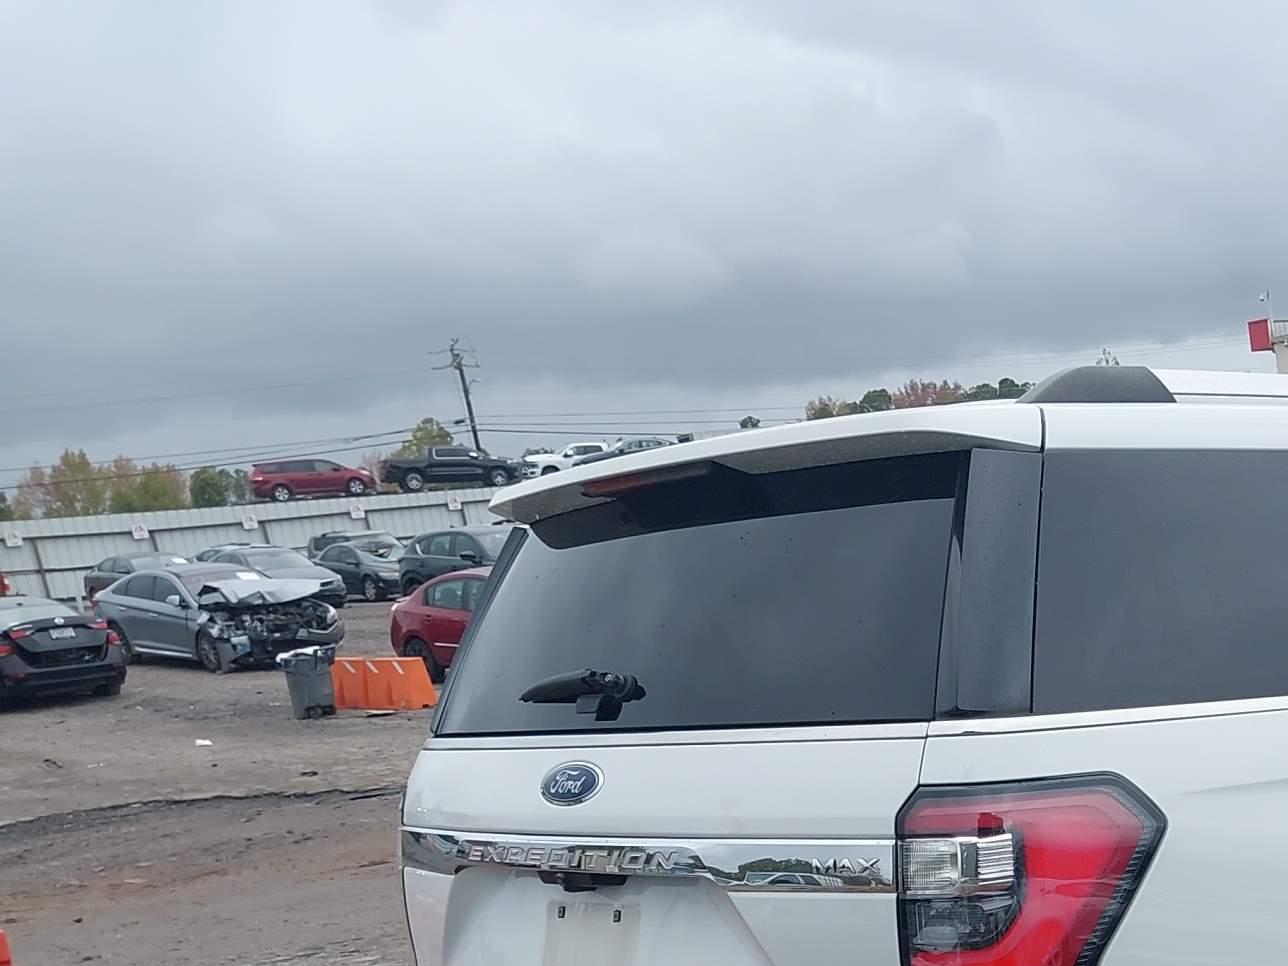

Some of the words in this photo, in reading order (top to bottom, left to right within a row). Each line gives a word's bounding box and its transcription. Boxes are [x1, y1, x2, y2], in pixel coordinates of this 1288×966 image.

[550, 769, 587, 793] Ford
[467, 845, 680, 869] EXPEDITION
[812, 858, 881, 874] MAX
